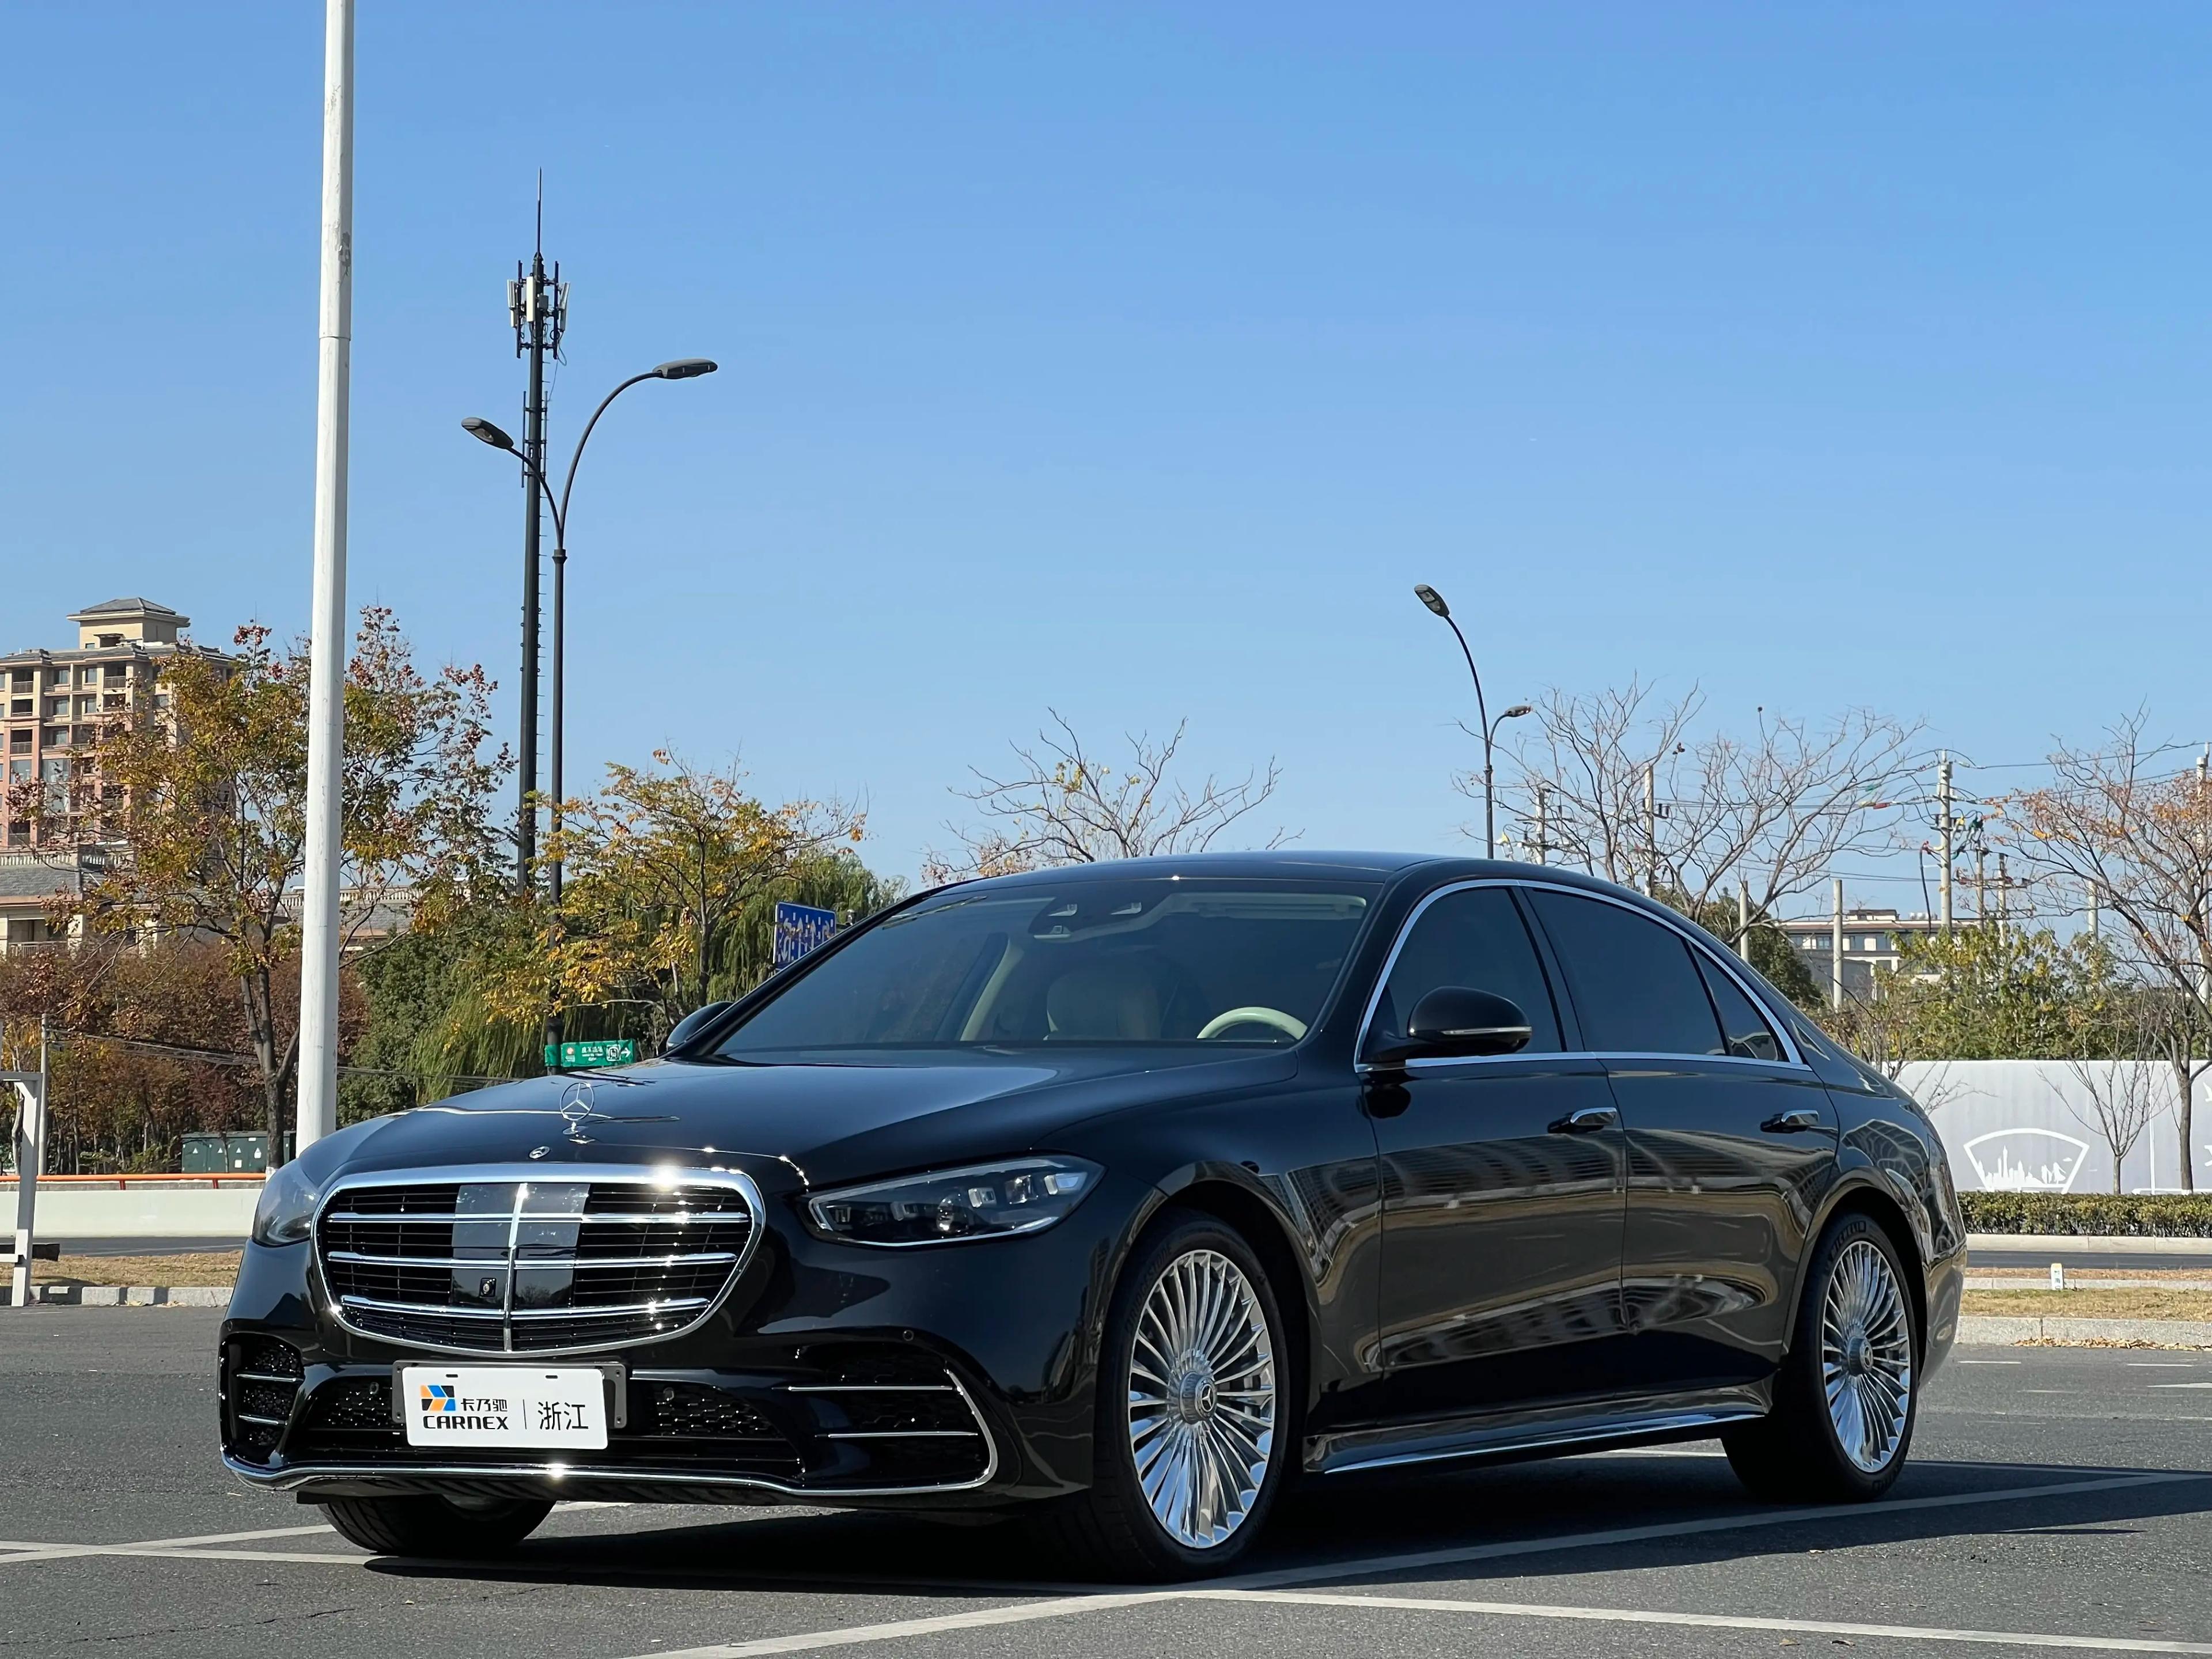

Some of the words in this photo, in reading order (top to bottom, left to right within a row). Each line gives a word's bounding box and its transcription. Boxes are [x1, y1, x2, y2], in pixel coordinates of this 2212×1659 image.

[461, 1399, 507, 1412] 卡乃驰
[423, 1415, 509, 1430] CARNEX
[538, 1402, 589, 1430] 浙江
